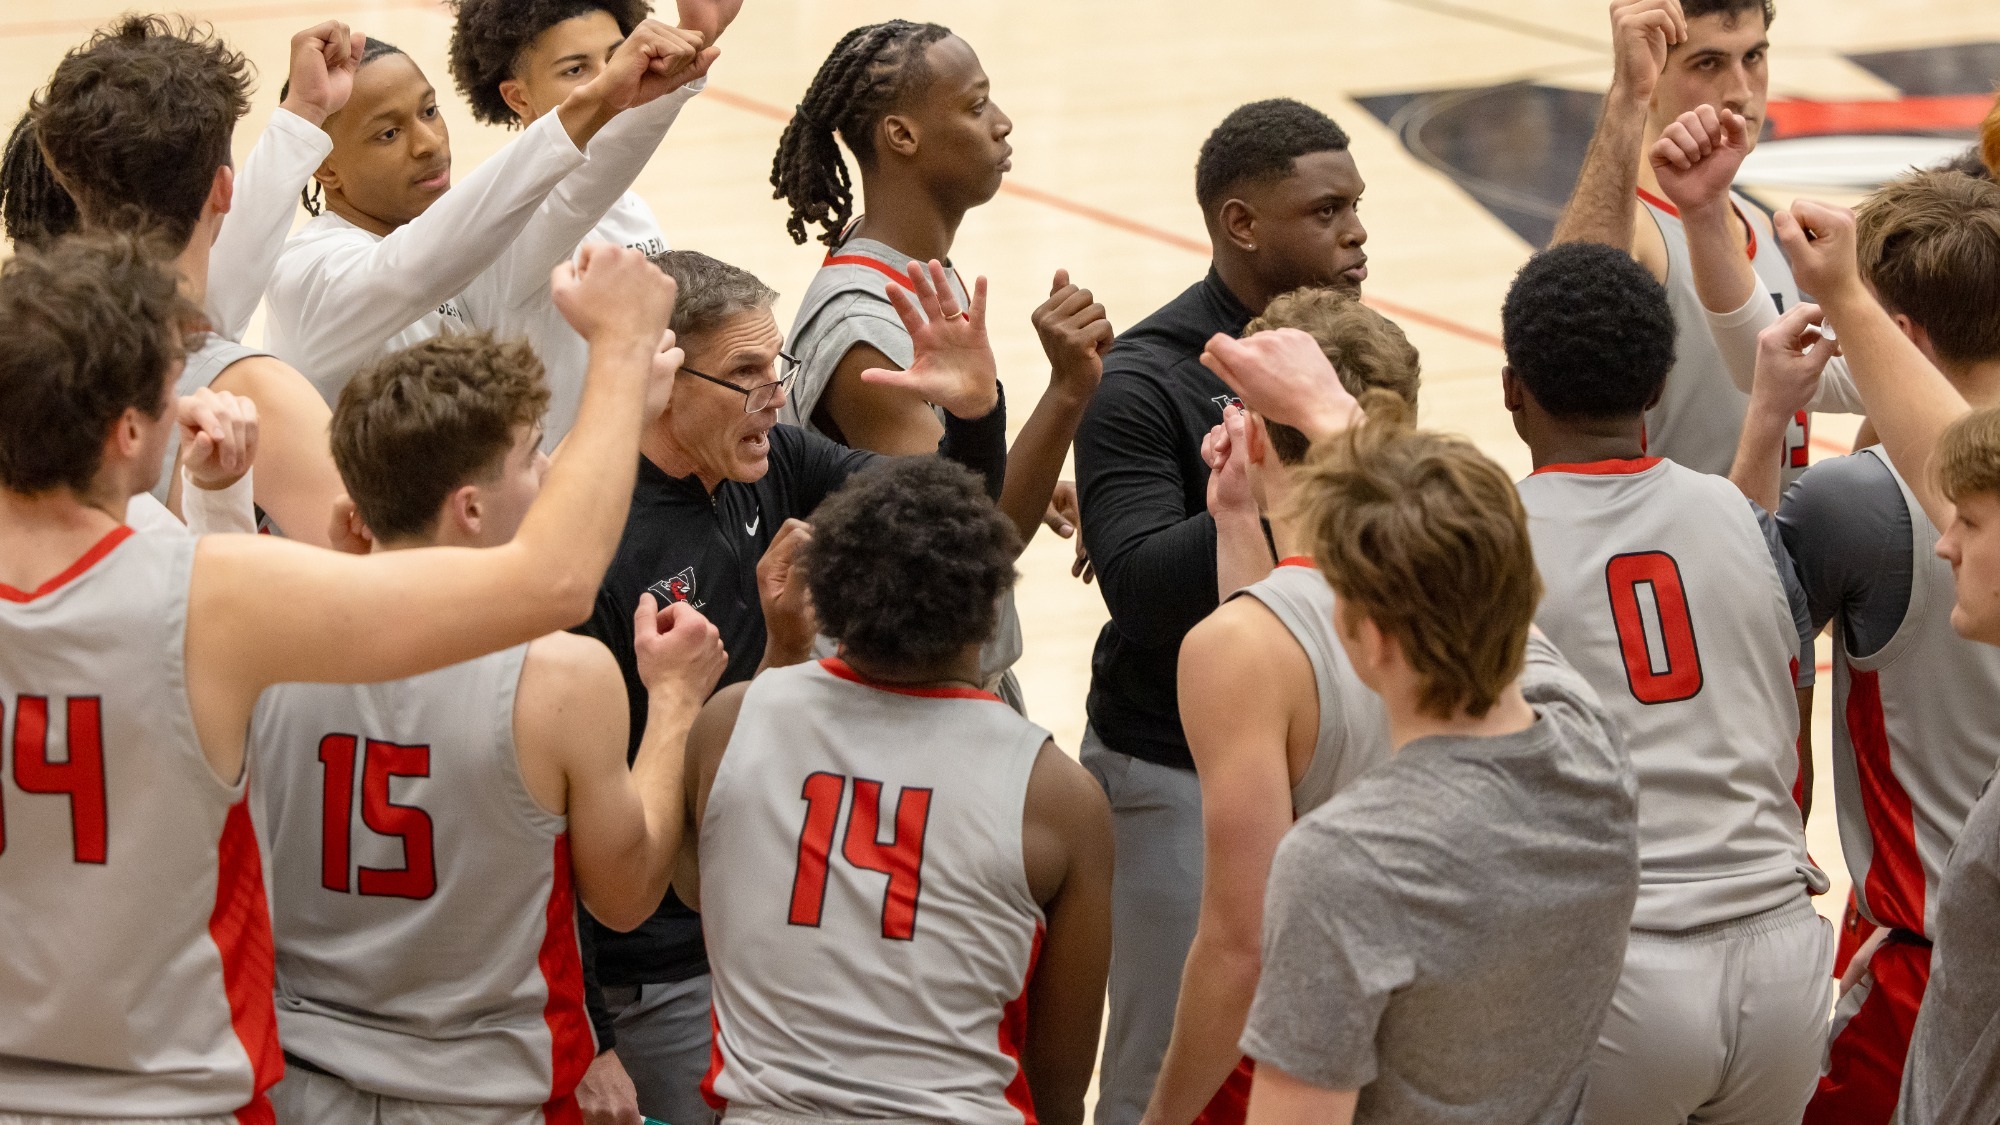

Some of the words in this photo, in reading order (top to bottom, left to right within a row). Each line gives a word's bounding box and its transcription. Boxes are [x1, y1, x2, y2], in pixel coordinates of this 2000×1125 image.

[1605, 550, 1704, 705] 0
[0, 694, 107, 864] 4
[318, 732, 438, 901] 15
[787, 770, 933, 941] 14
